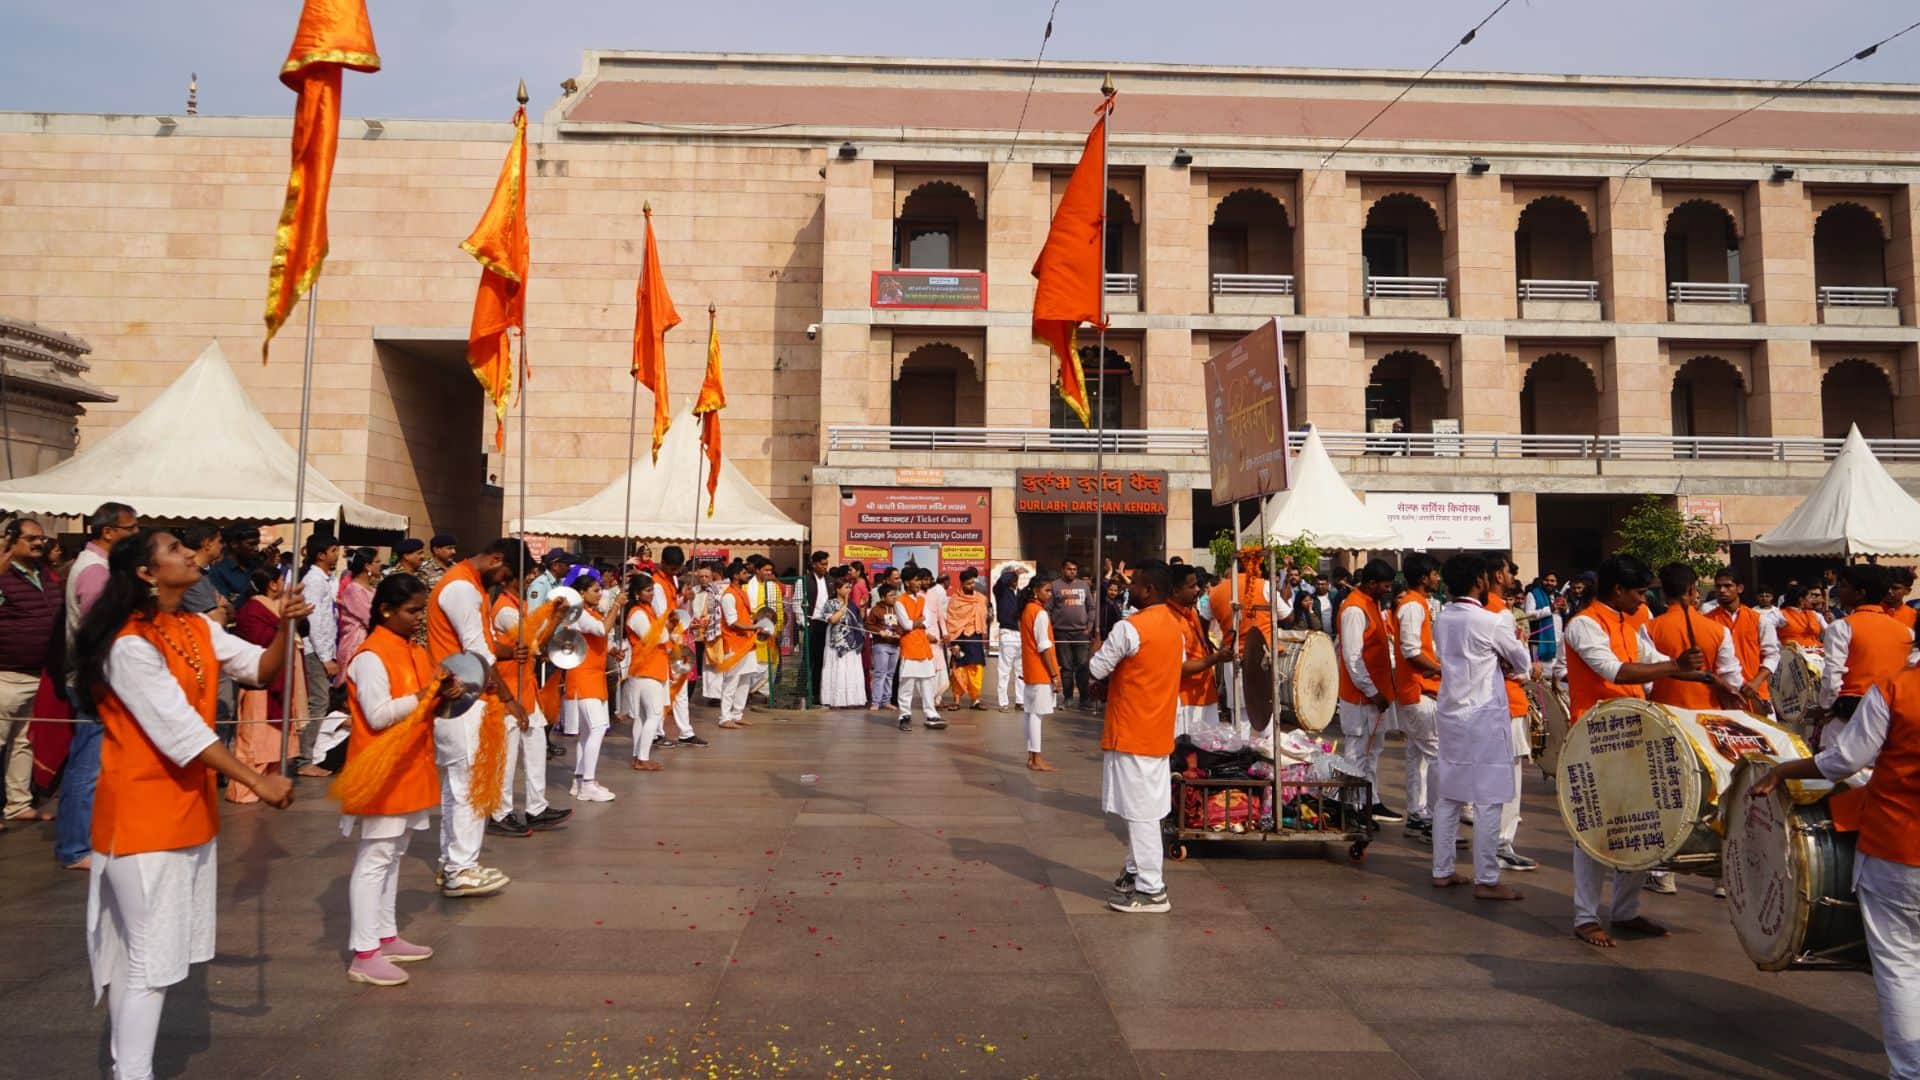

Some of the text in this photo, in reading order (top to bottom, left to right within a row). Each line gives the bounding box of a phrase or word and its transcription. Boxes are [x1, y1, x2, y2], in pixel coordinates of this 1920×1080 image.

[1020, 500, 1067, 512] DURLABH
[1124, 502, 1164, 513] KENDRA
[1421, 501, 1445, 513] सर्विस
[917, 515, 939, 523] Ticket
[850, 531, 978, 541] Language Support & Enquiry Counter
